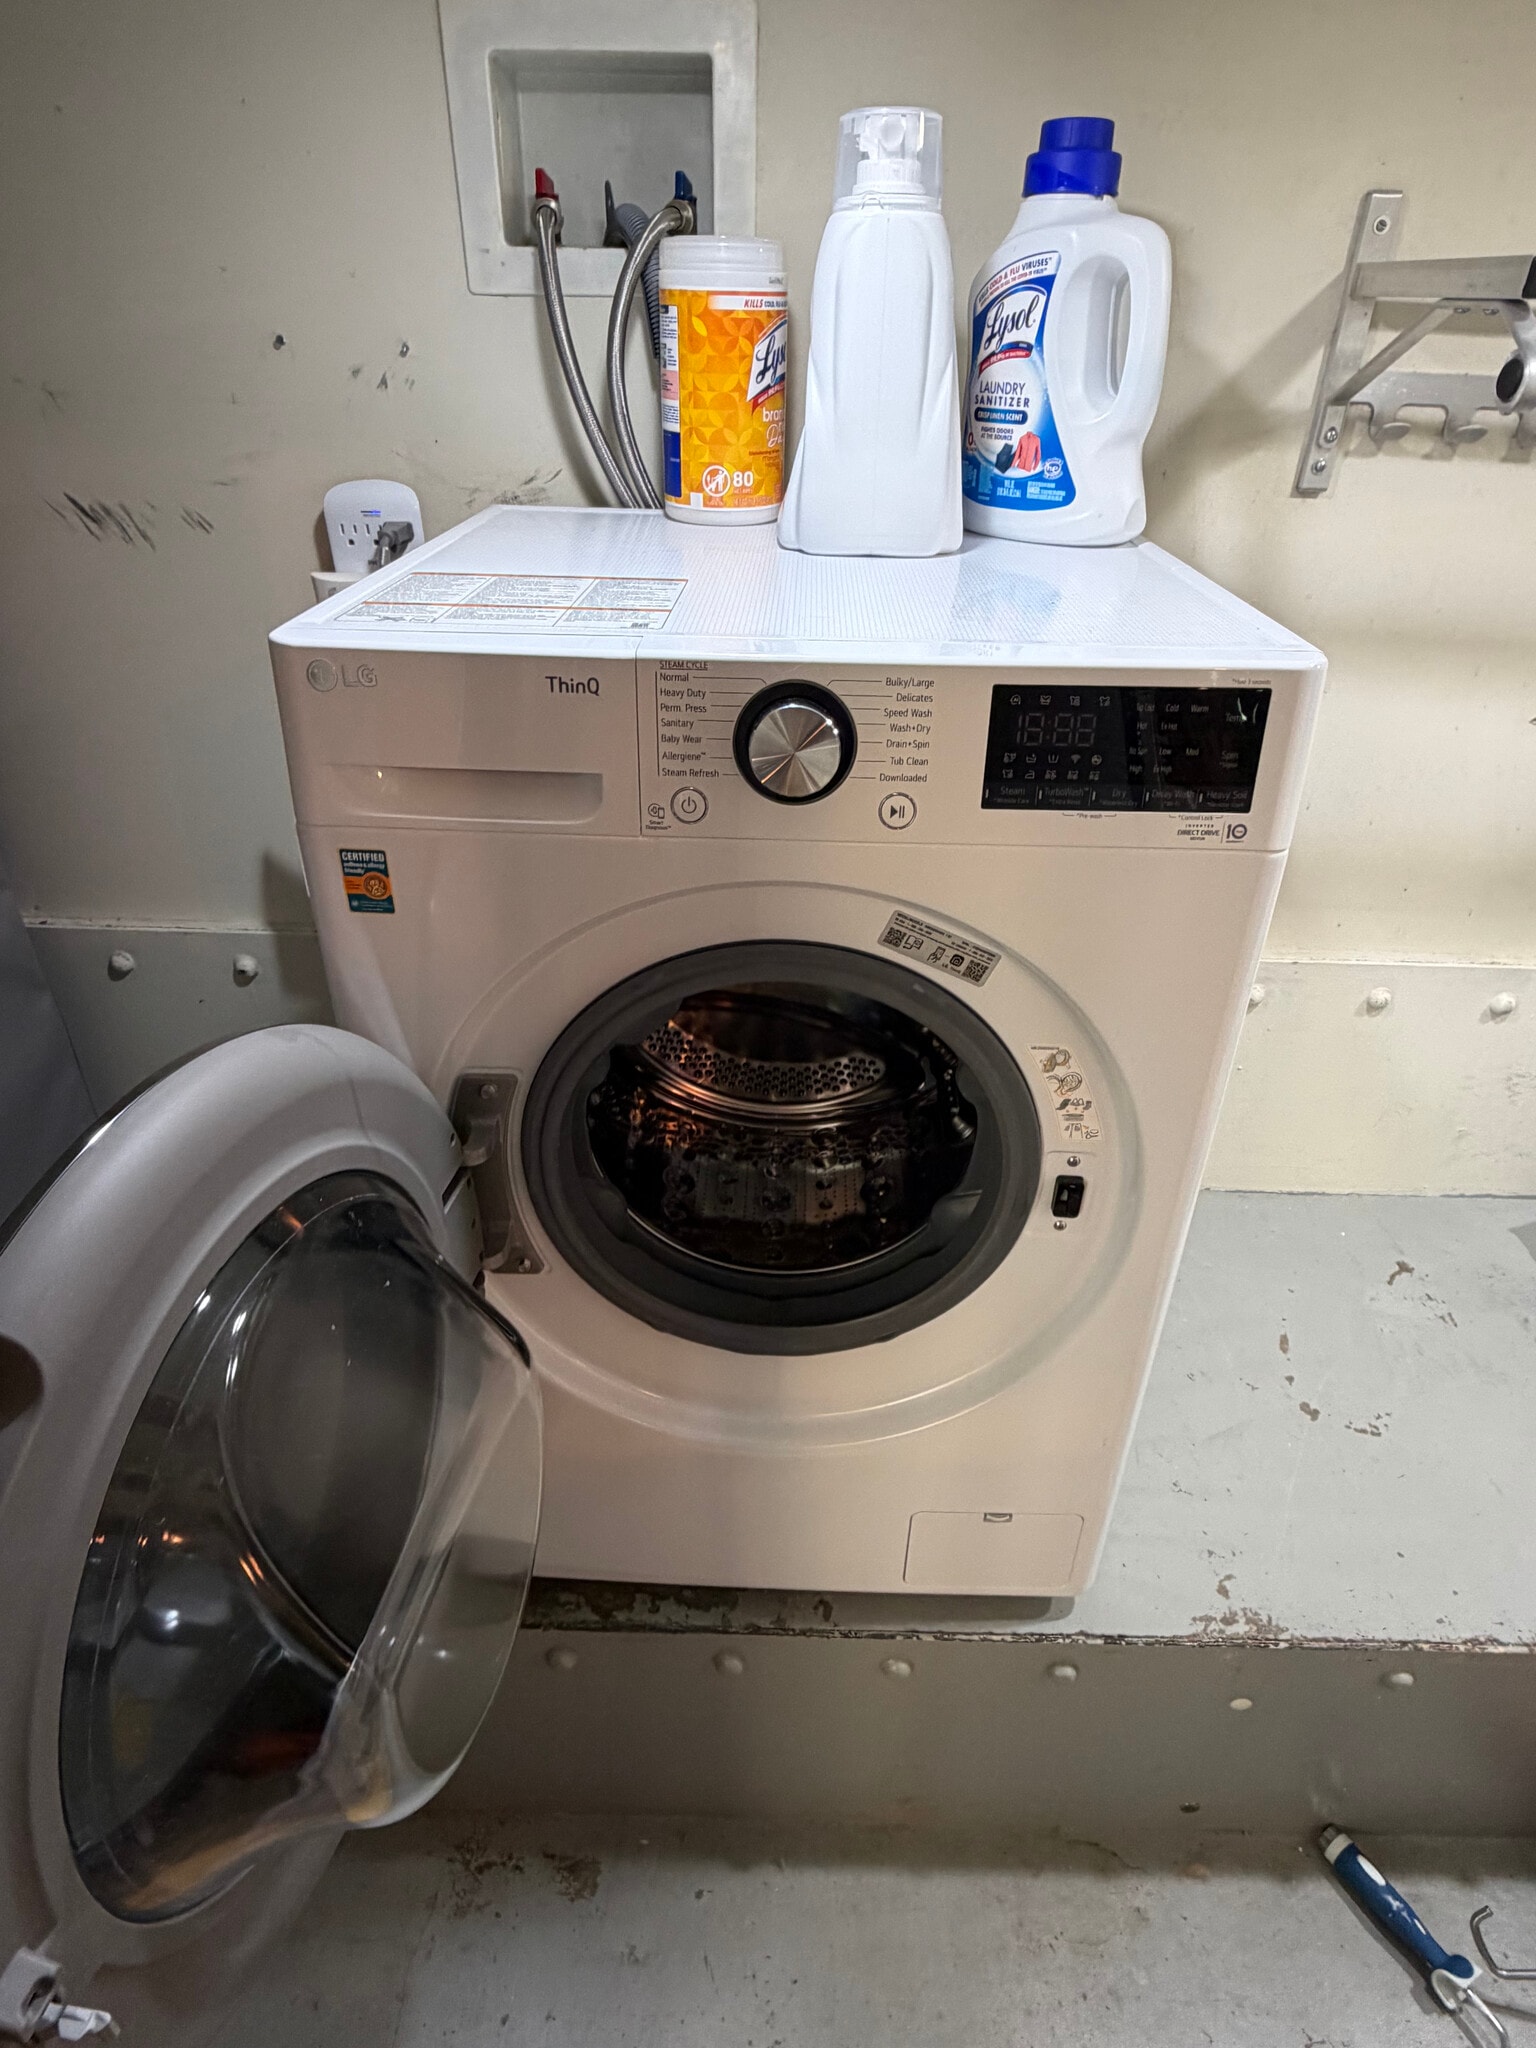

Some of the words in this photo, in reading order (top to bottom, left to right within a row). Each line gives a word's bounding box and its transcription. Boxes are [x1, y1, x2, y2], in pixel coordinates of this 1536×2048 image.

[744, 299, 764, 308] KILLS
[984, 294, 1040, 350] Lysol
[979, 381, 1026, 395] LAUNDRY
[974, 395, 1030, 408] SANITIZER
[1005, 412, 1023, 421] SCENT
[733, 471, 754, 487] 80
[659, 661, 685, 669] STEAM
[686, 662, 708, 670] CYCLE
[342, 664, 378, 688] LG
[660, 673, 689, 681] Normal
[545, 676, 600, 696] ThinQ
[885, 677, 935, 688] Bulky/Large
[660, 688, 685, 698] Heavy
[687, 690, 707, 699] Duty
[896, 693, 934, 703] Delicates
[660, 703, 682, 712] Perm.
[685, 704, 707, 713] Press
[1165, 704, 1179, 712] Cold
[1190, 704, 1209, 713] Warm
[883, 708, 909, 719] Speed
[910, 708, 933, 718] Wash
[660, 719, 695, 729] Sanitary
[661, 734, 680, 744] Baby
[682, 735, 703, 743] Wear
[890, 756, 904, 766] Tub
[906, 757, 929, 766] Clean
[661, 768, 687, 777] Steam
[689, 769, 720, 778] Refresh
[879, 773, 928, 783] Downloaded
[1000, 786, 1026, 796] Steam
[1112, 788, 1127, 799] Dry
[1207, 790, 1231, 801] Heavy
[1232, 790, 1248, 800] Soil
[1226, 824, 1248, 839] 10
[341, 851, 385, 862] CERTIFIED
